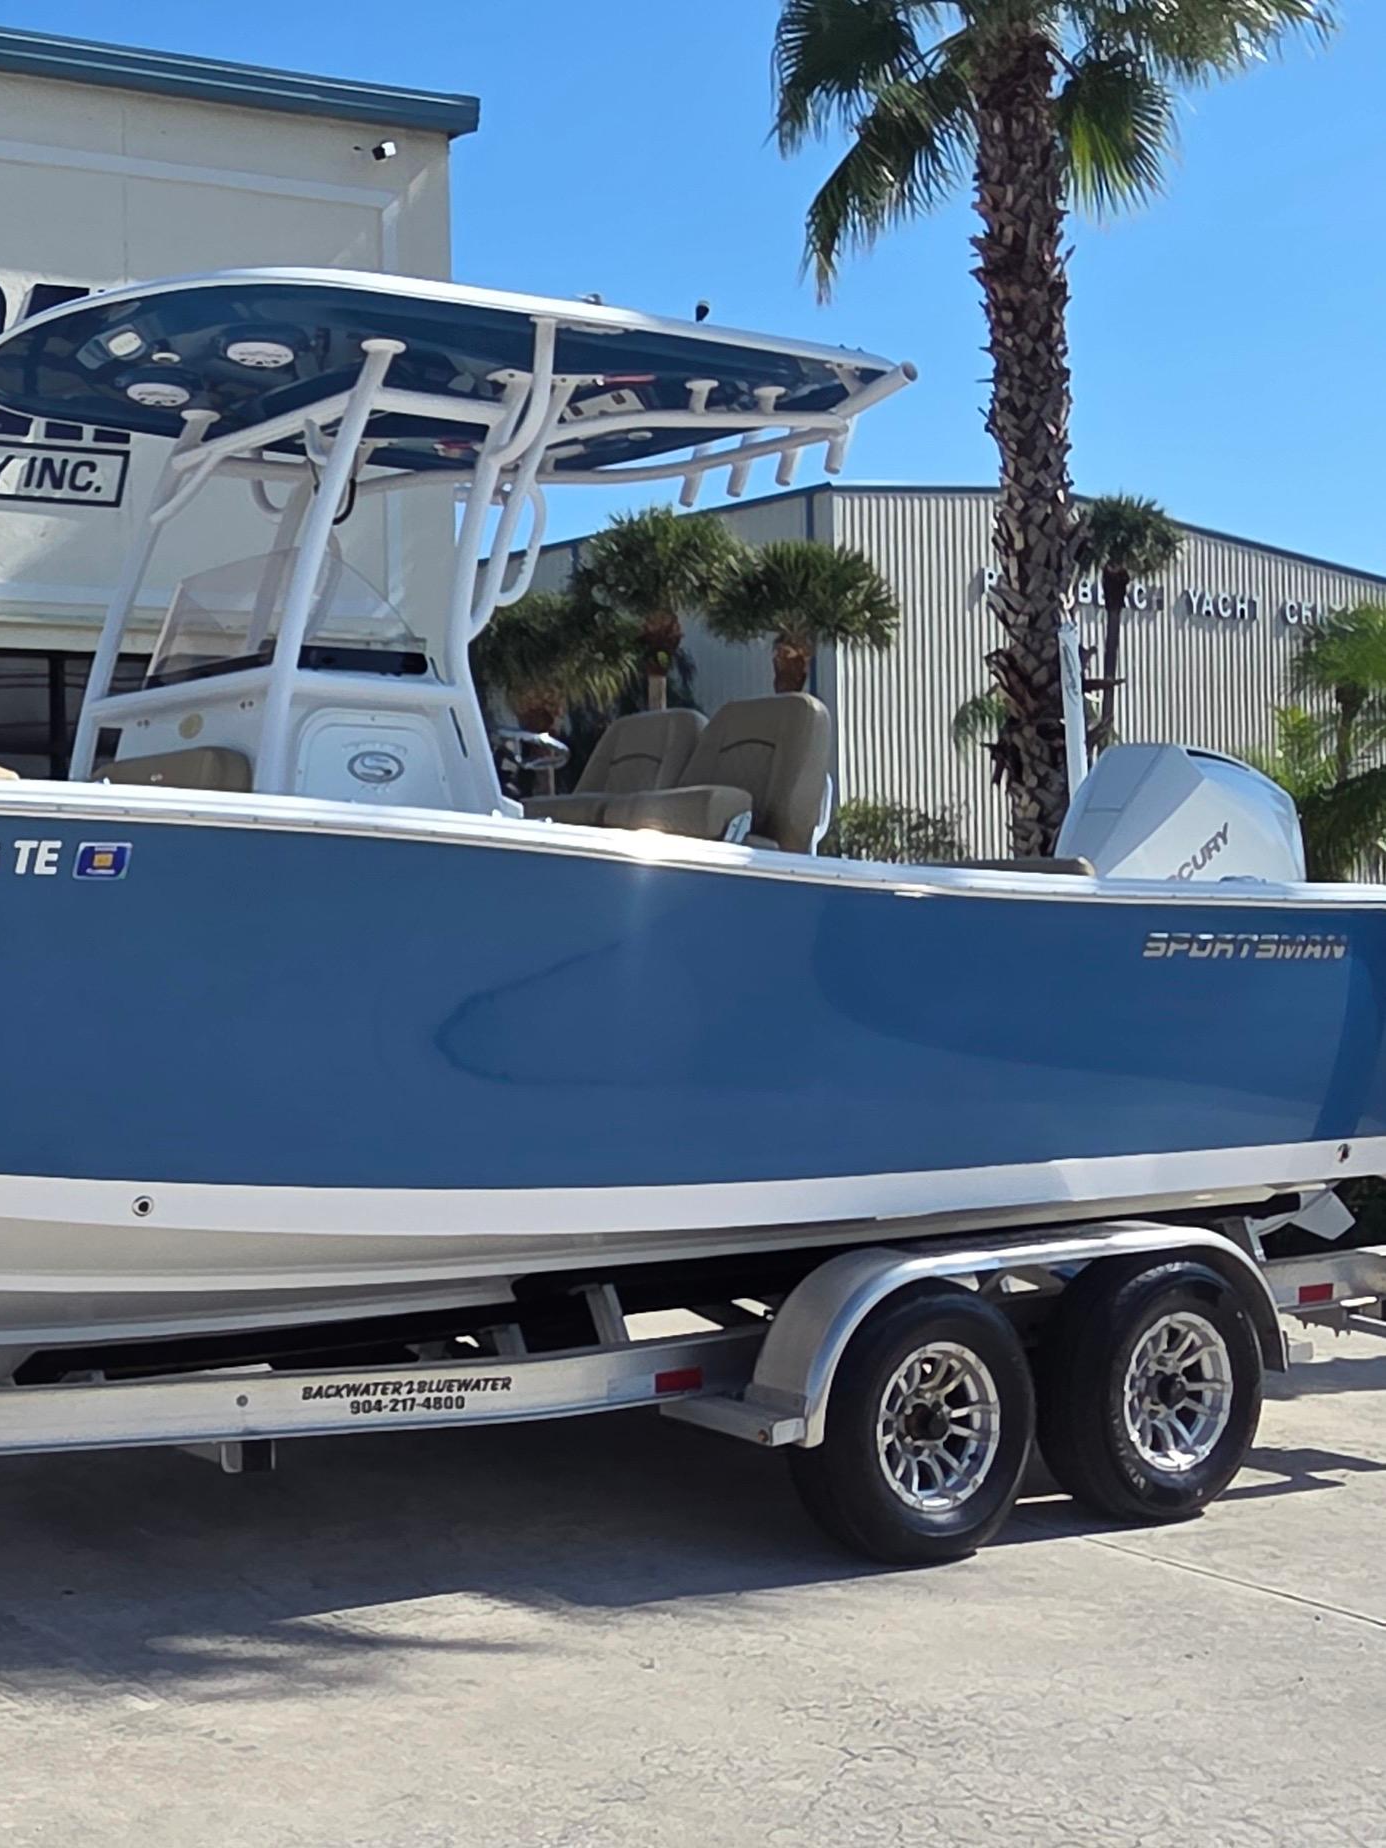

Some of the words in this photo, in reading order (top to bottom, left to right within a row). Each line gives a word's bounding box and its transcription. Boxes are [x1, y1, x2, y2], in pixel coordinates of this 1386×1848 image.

[24, 456, 103, 494] INC.
[14, 840, 62, 875] TE
[1166, 821, 1229, 881] CURY
[1142, 932, 1348, 960] SPORTSMAN
[349, 1395, 465, 1415] 904-217-4800
